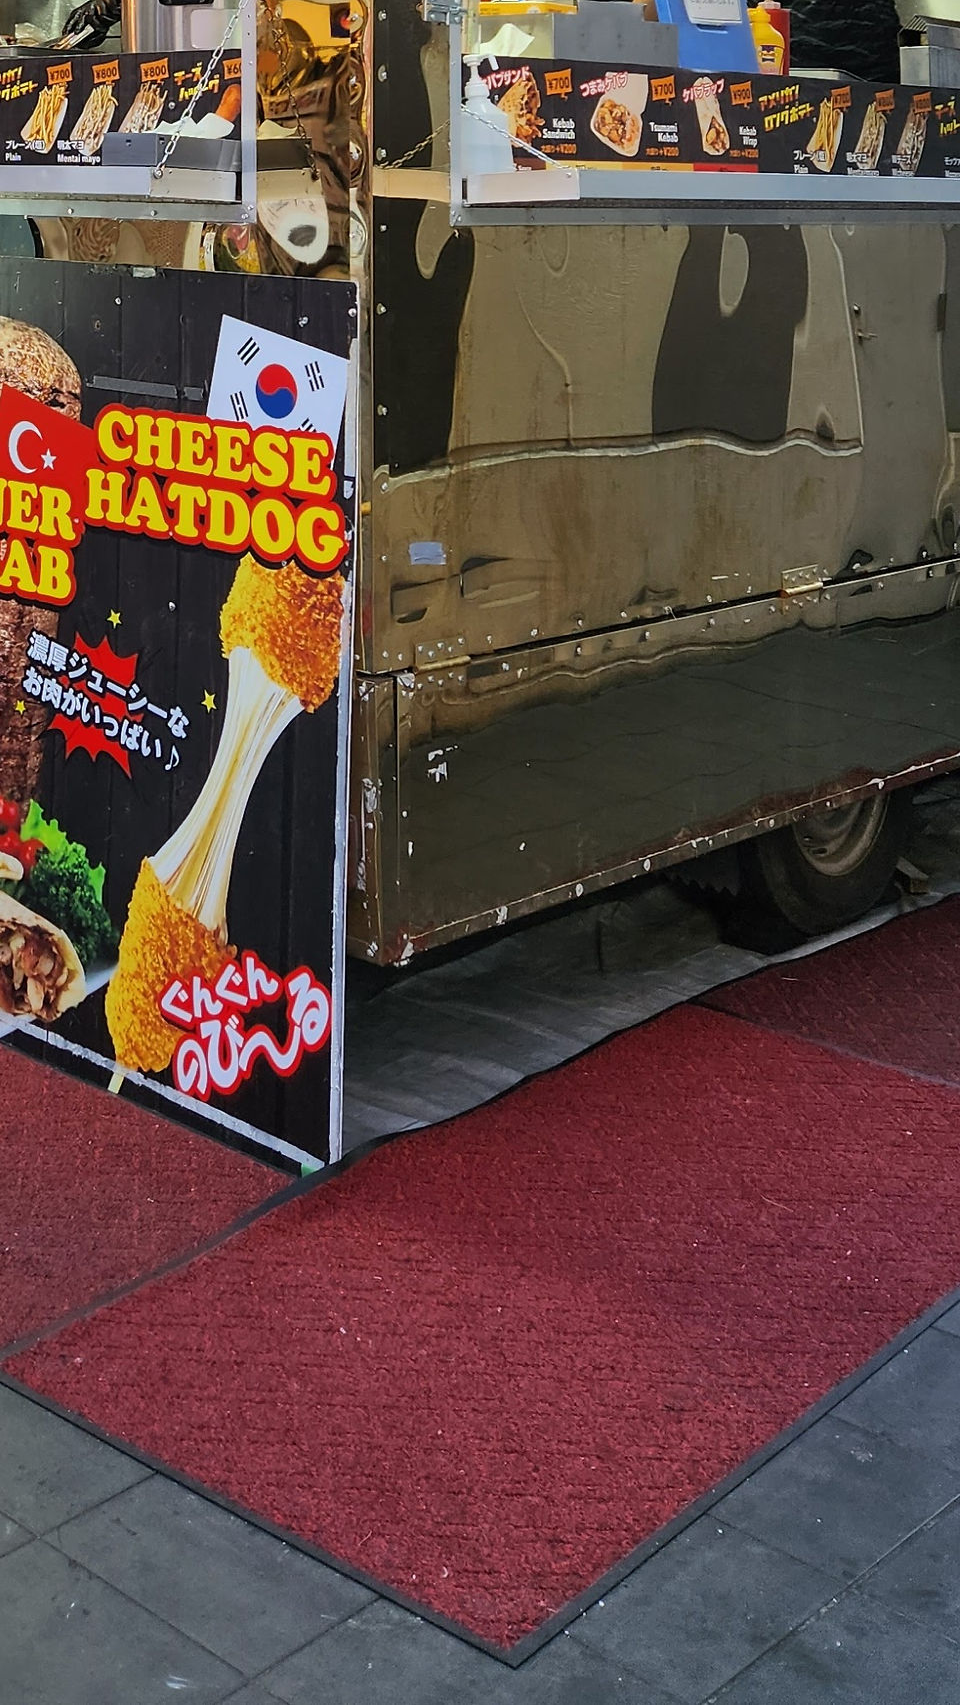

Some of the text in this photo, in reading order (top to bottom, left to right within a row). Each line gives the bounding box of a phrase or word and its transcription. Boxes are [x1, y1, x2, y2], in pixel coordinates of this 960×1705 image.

[96, 67, 117, 79] ¥800
[143, 65, 166, 77] ¥800
[174, 62, 202, 85] チーズ
[226, 63, 242, 74] ¥6
[50, 69, 70, 81] ¥700
[547, 77, 570, 90] ¥700
[579, 71, 628, 97] つまみケバブ
[653, 83, 674, 95] ¥700
[682, 78, 725, 103] ケバブラップ
[552, 118, 575, 129] Kebab
[542, 128, 576, 140] Sandwich
[739, 126, 757, 136] Kebab
[657, 132, 678, 143] Kebab
[742, 136, 758, 147] Wrap
[5, 153, 21, 161] Plain
[57, 154, 100, 165] Mentai mayo
[794, 164, 808, 174] Plain
[97, 410, 331, 496] CHEESE
[85, 469, 343, 565] HATDOG
[27, 630, 190, 739] 濃厚ジューシーな
[161, 957, 278, 1022] ぐんぐん
